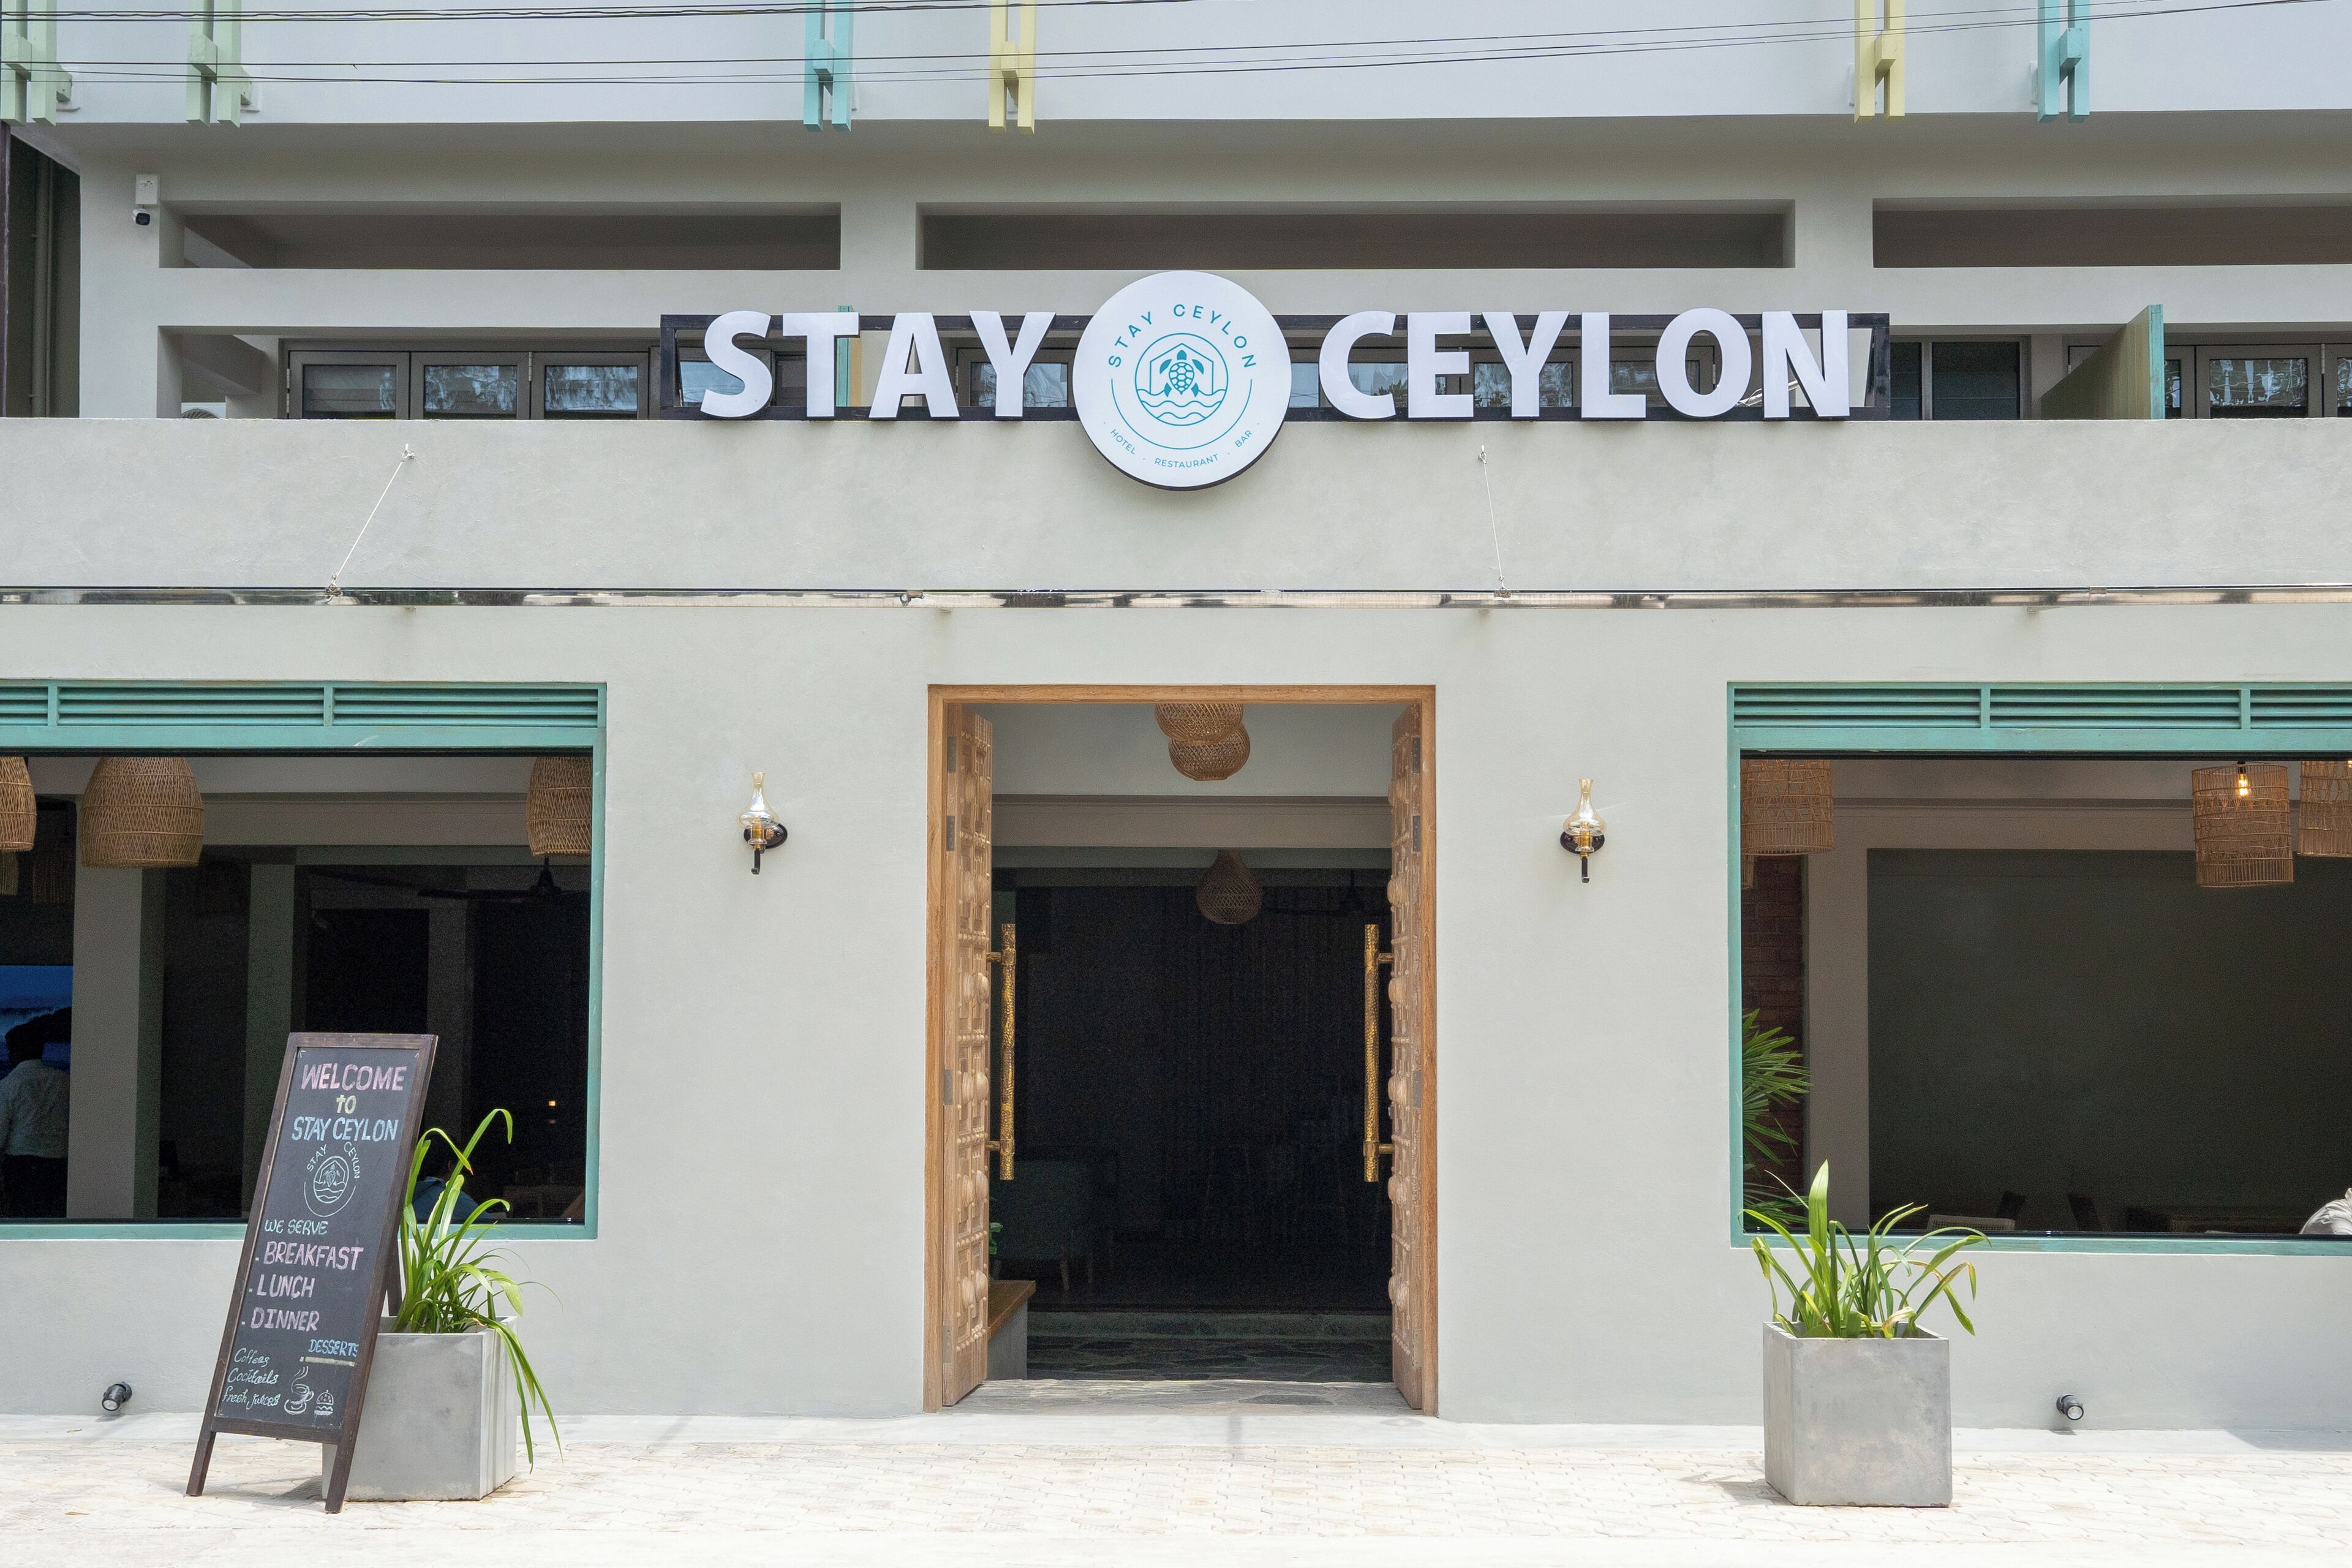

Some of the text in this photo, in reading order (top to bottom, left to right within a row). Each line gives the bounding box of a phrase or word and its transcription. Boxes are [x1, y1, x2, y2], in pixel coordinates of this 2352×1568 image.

[1108, 304, 1257, 368] STAY CEYLON
[699, 307, 1851, 420] STAY CEYLON
[1110, 429, 1253, 469] HOTEL RESTAURANT BAR
[300, 1063, 407, 1091] WELCOME
[291, 1116, 399, 1142] STAY CEYLON
[306, 1141, 361, 1179] STAY CEYLON
[265, 1219, 329, 1235] WE SERVE
[263, 1241, 364, 1271] BREAKFAST
[256, 1273, 315, 1298] LUNCH
[250, 1307, 320, 1332] DINNER
[234, 1348, 270, 1368] Coffees
[307, 1339, 360, 1358] DESSERTS
[227, 1367, 279, 1385] Cocktails
